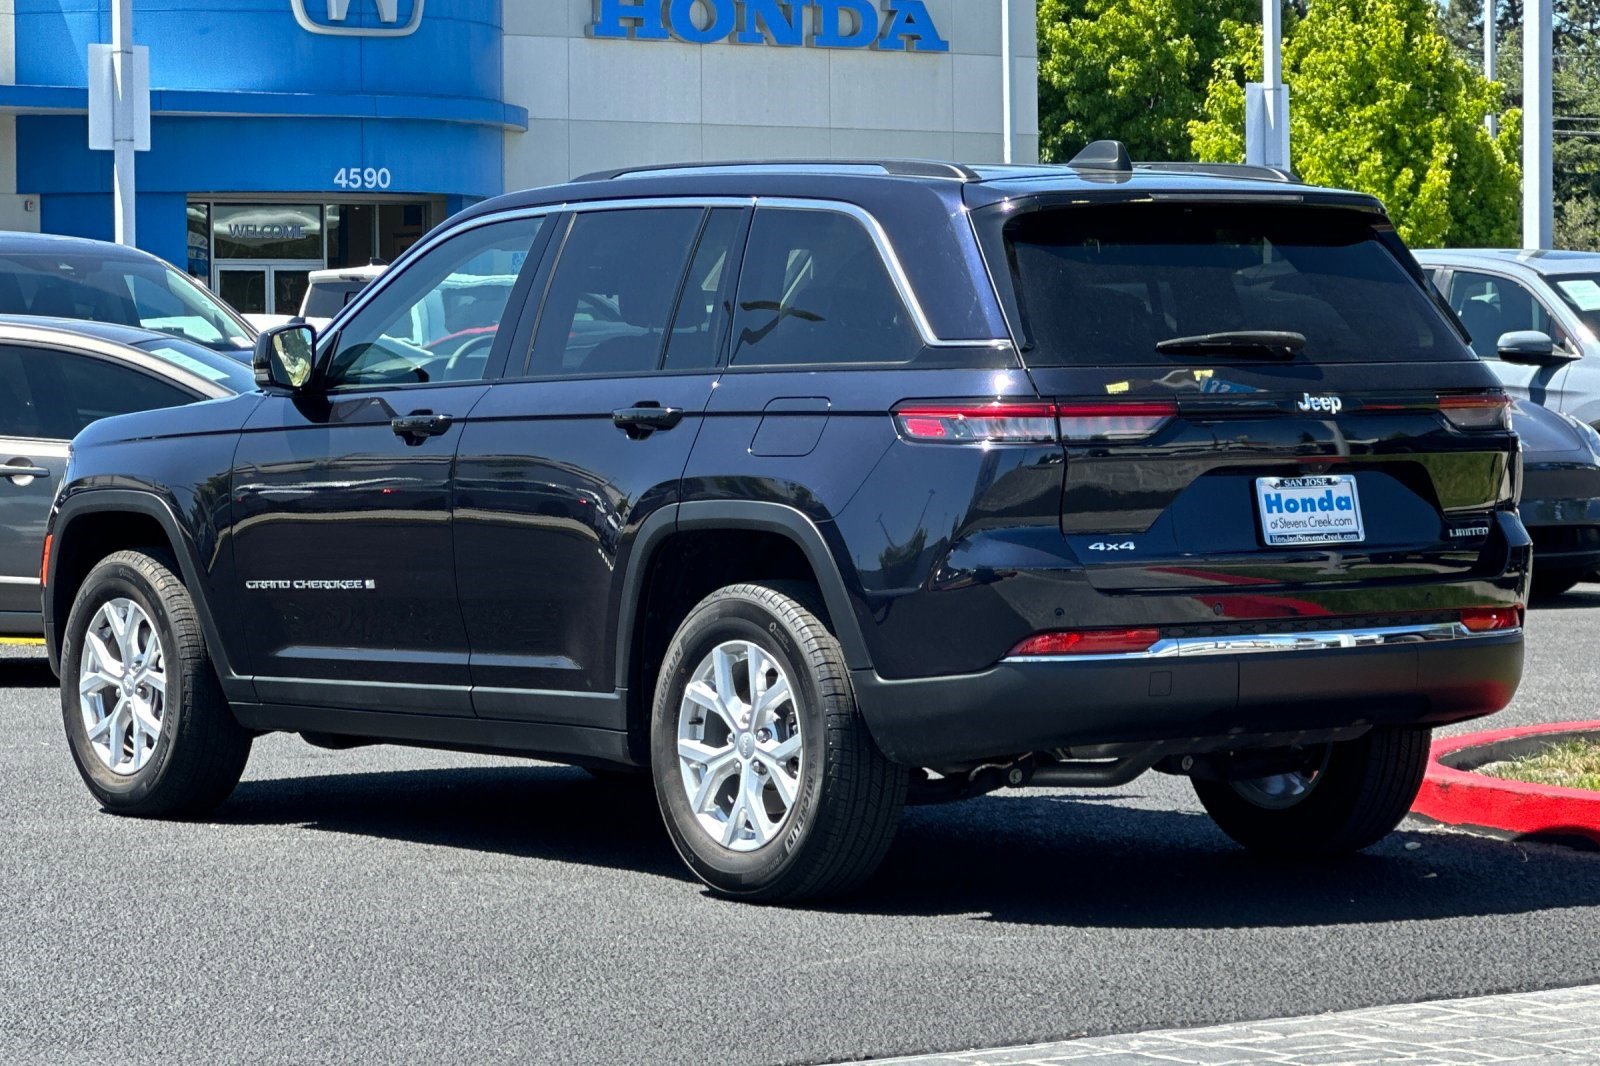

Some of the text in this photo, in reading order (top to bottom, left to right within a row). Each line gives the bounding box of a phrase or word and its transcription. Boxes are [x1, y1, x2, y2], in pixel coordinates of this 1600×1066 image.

[588, 0, 949, 52] HONDA
[333, 167, 391, 189] 4590
[228, 223, 306, 240] WELCOME
[1297, 392, 1342, 415] Jeep
[1284, 478, 1328, 487] SAN JOSE
[1264, 490, 1352, 514] Honda
[1448, 526, 1489, 538] LIMITED
[1088, 541, 1136, 551] 4x4
[246, 579, 363, 590] GRAND CHEROKEE
[657, 645, 681, 719] MICHELIN
[787, 775, 814, 849] MICHELIN
